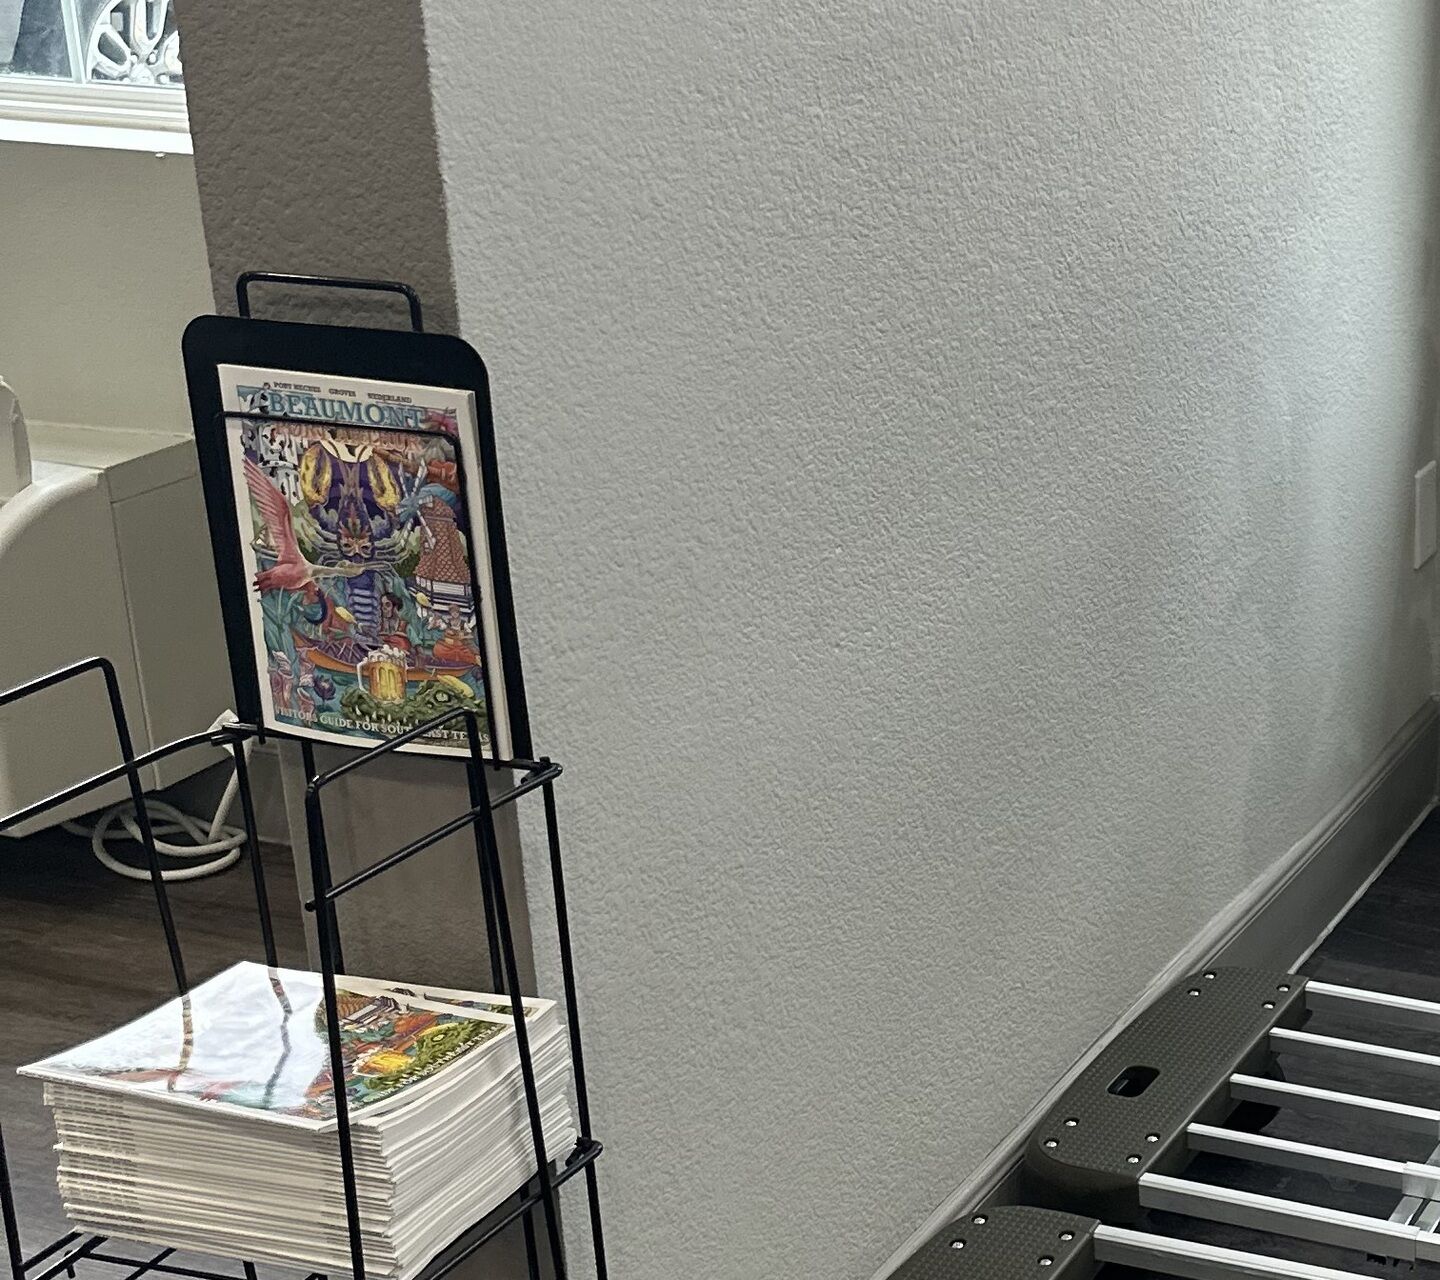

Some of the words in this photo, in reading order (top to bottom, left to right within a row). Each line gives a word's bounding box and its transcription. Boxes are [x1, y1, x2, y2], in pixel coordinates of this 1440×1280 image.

[268, 392, 424, 429] BEAUMONT
[319, 715, 354, 729] GUIDE
[355, 720, 379, 732] FOR
[452, 730, 490, 742] TEAS
